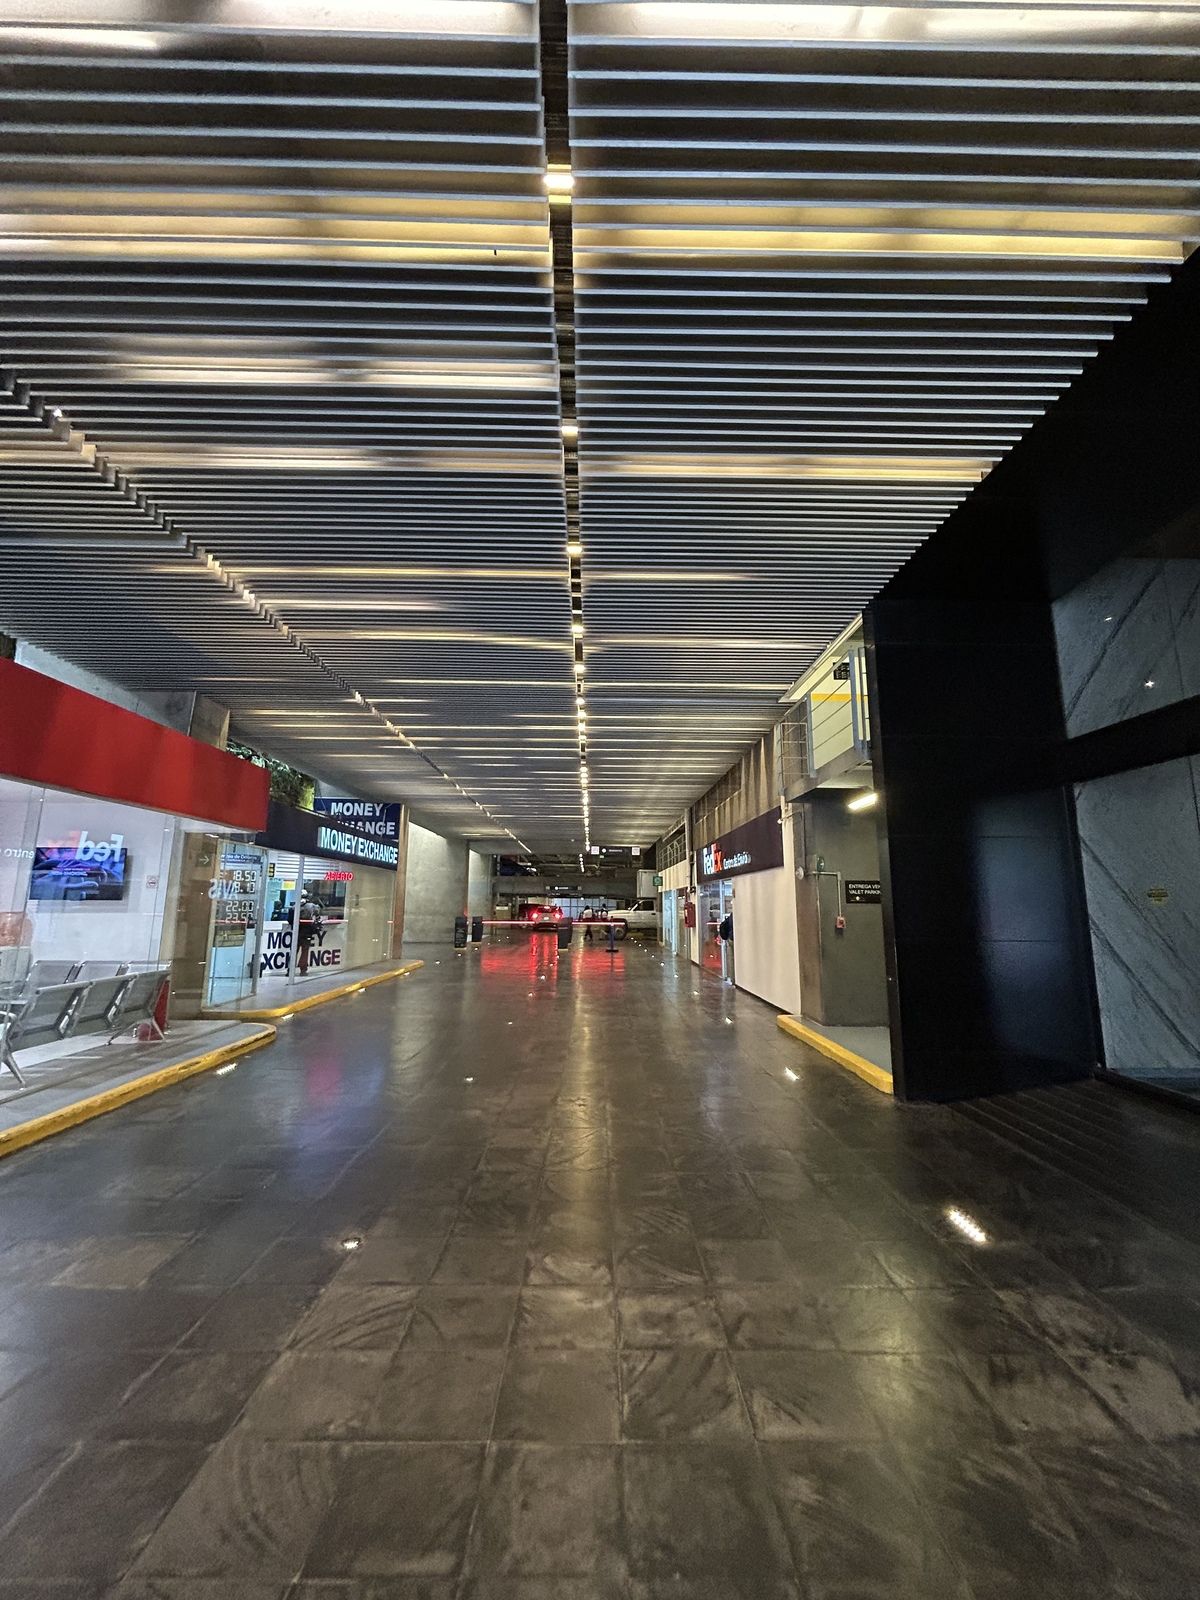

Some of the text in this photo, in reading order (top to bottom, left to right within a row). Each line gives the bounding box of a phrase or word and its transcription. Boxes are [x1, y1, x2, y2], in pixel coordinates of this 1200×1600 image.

[330, 802, 383, 817] MONEY
[337, 820, 396, 836] ANGE
[320, 826, 398, 864] MONEY EXCHANGE
[703, 843, 723, 874] FedEx
[233, 870, 257, 882] 18.50
[325, 871, 354, 880] ABIERTO
[225, 901, 254, 912] 22.00
